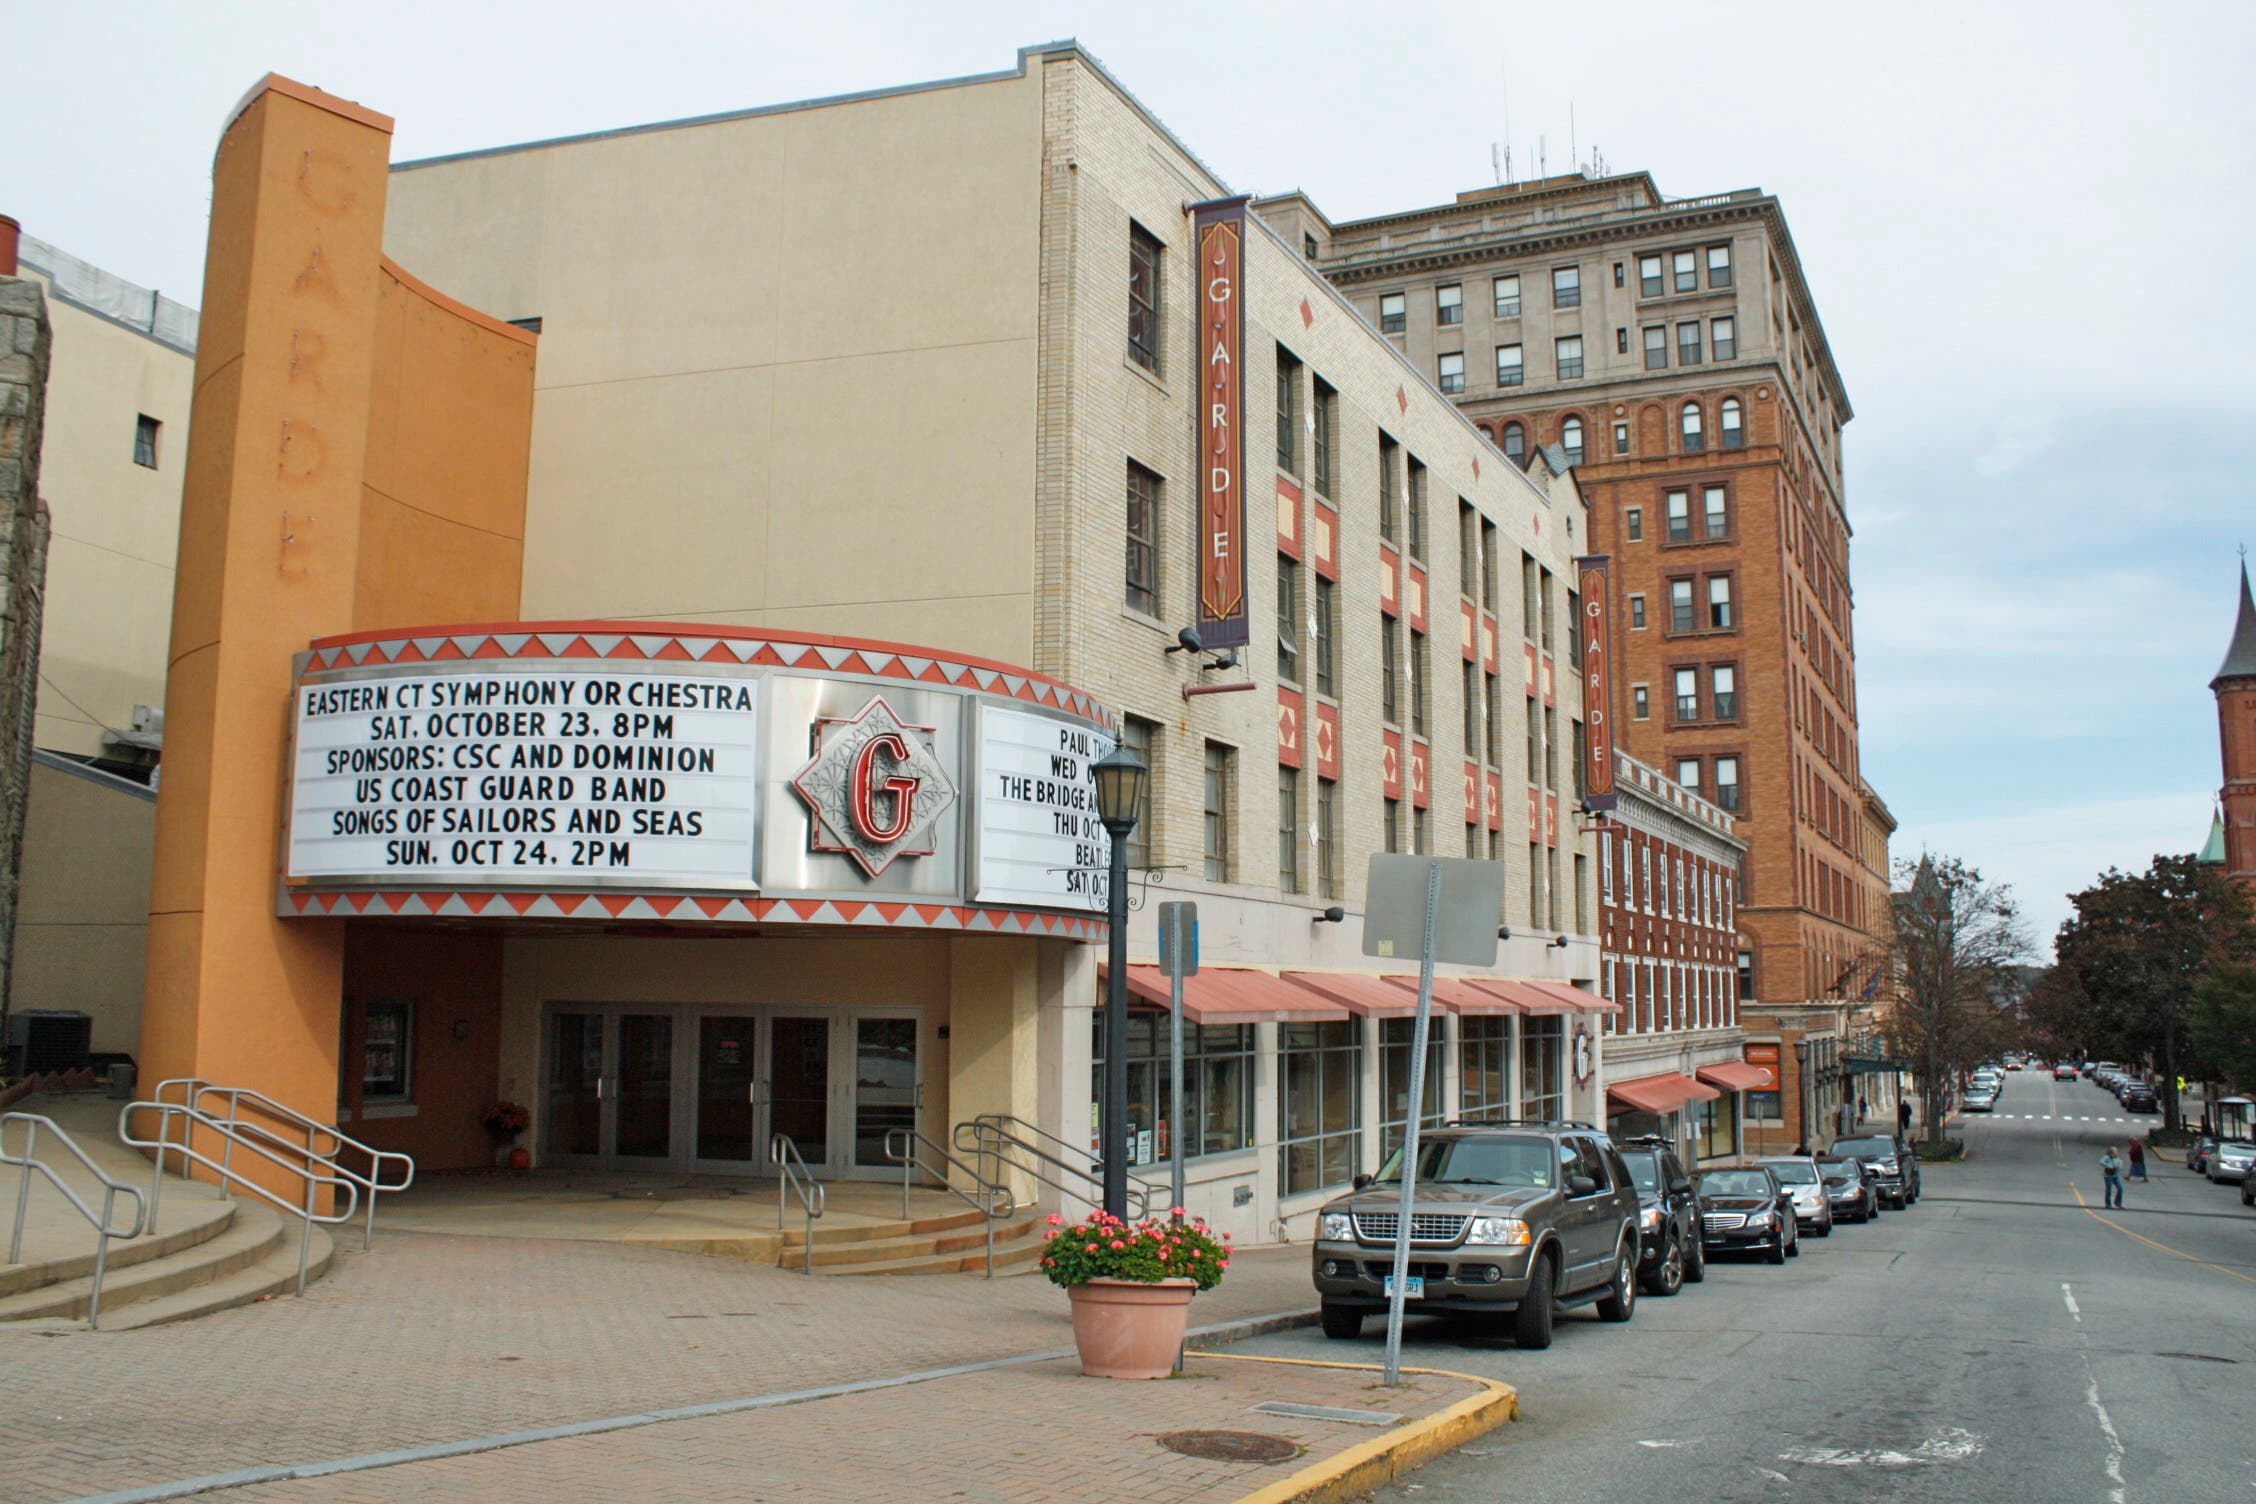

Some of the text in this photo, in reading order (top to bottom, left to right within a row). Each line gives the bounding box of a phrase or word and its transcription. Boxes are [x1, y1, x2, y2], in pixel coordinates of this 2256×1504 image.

[1208, 276, 1232, 561] GARDE
[1586, 601, 1603, 762] GARDE
[306, 680, 753, 717] EASTERN CT SYMPHONY ORCHESTRA
[426, 711, 546, 739] OCTOBER
[612, 712, 674, 740] 8PM
[1060, 729, 1090, 757] PAUL
[326, 743, 715, 775] SPONSORS: CSC AND DOMINION
[1051, 754, 1077, 780] WED
[356, 775, 667, 804] US COAST GUARD BAND
[1000, 776, 1031, 801] THE
[1037, 780, 1085, 811] BRIDGE
[332, 807, 704, 837] SONGS OF SAILORS AND SEAS
[1053, 812, 1078, 837] THU
[1083, 817, 1101, 841] OCT
[451, 839, 505, 866] OCT
[571, 840, 631, 867] 2PM
[1067, 870, 1108, 896] SAT OCT
